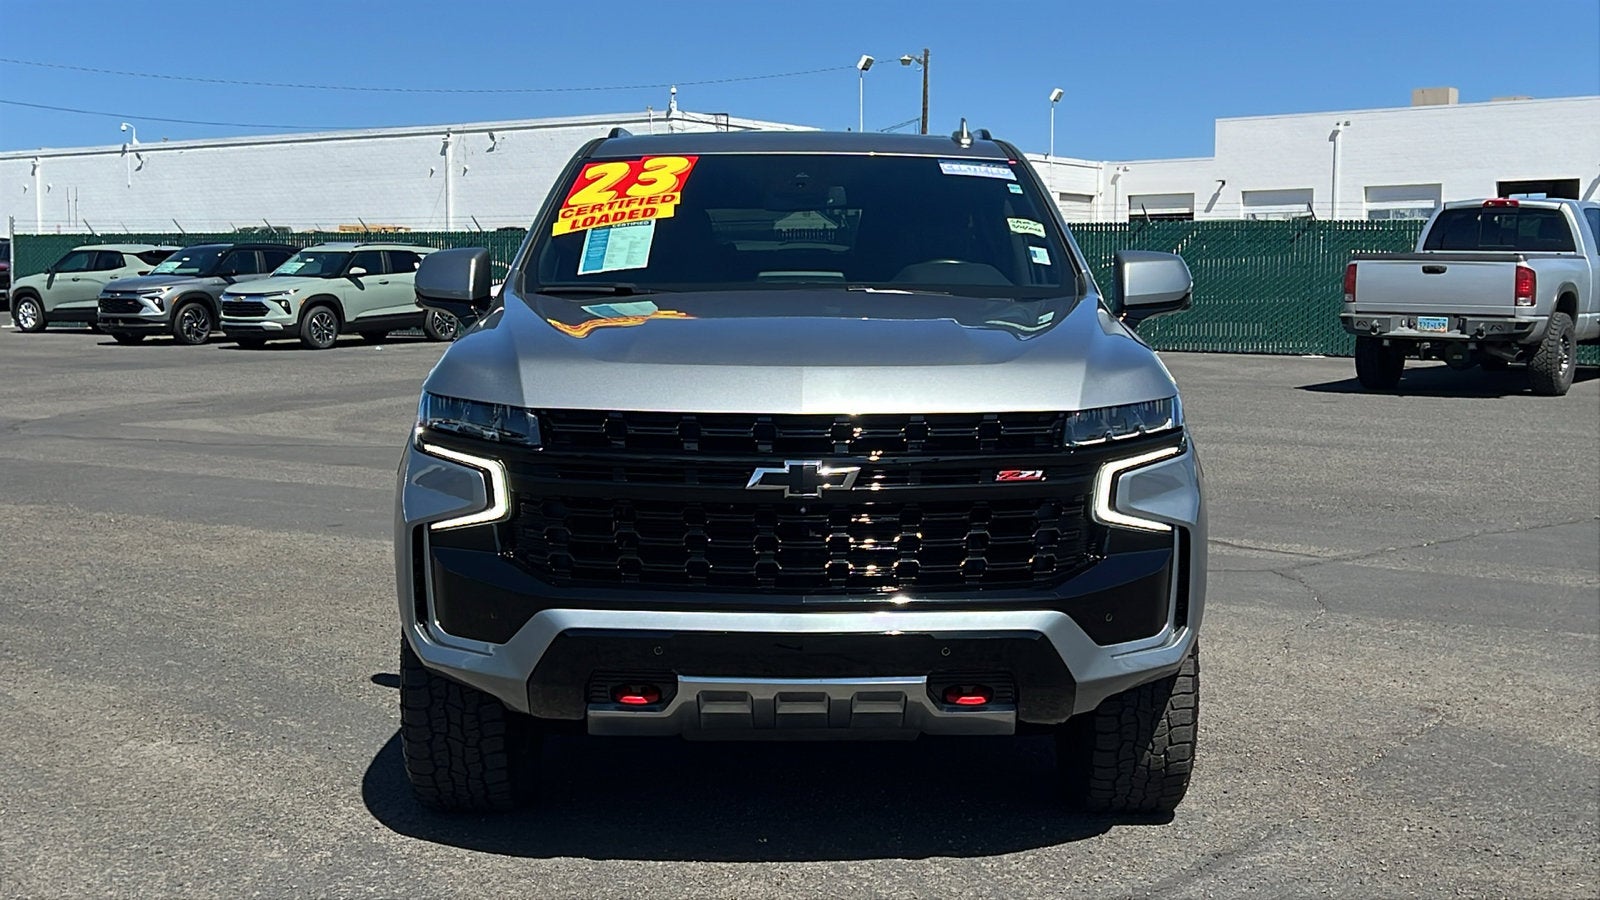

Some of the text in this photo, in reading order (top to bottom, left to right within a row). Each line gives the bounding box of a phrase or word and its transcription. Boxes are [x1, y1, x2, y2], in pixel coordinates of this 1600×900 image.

[568, 156, 692, 206] 23
[561, 194, 677, 219] CERTIFIED
[570, 207, 658, 230] LOADED
[611, 220, 650, 229] CERTIFIED
[995, 469, 1044, 481] Z71
